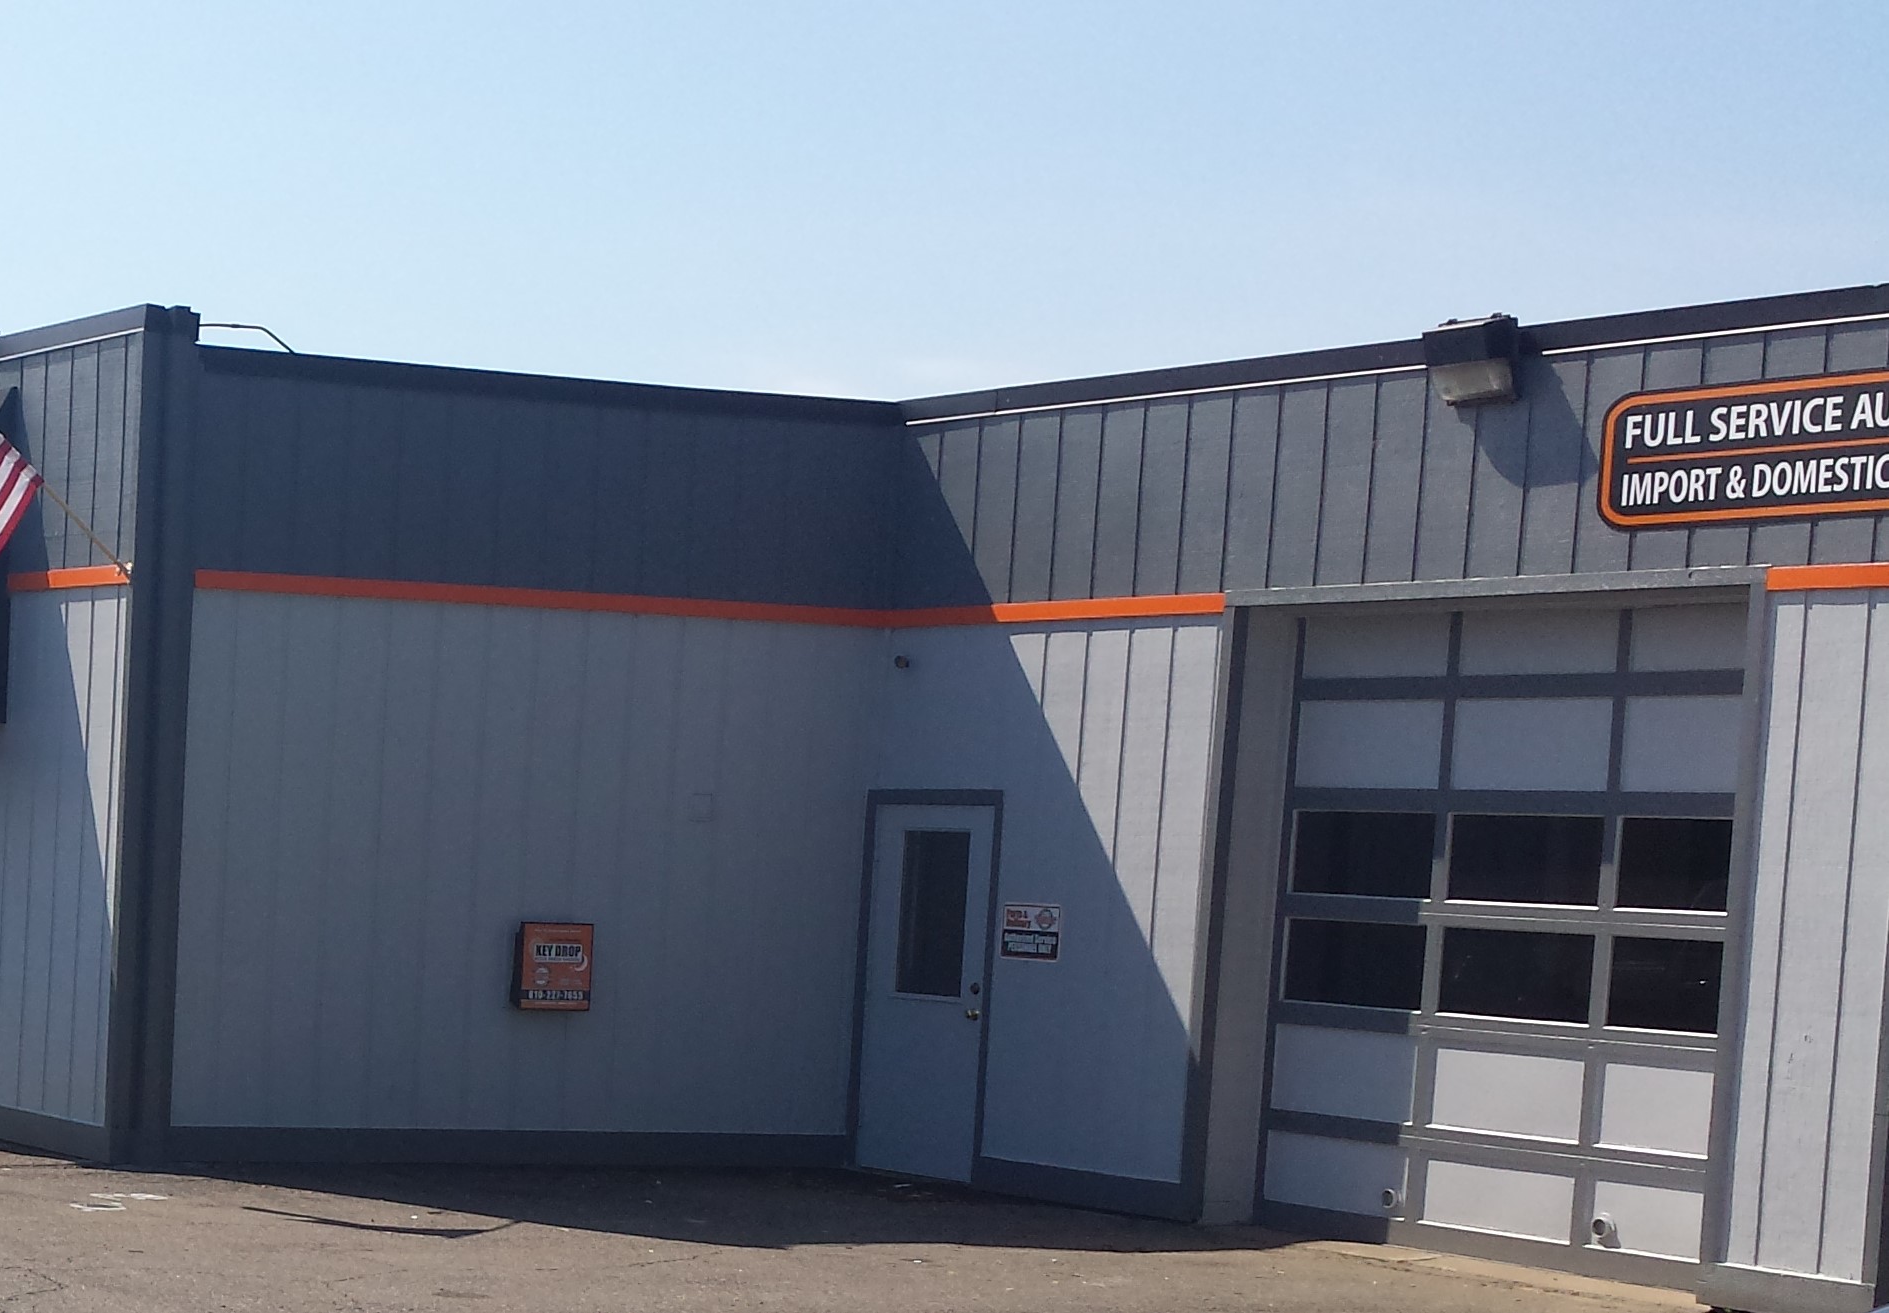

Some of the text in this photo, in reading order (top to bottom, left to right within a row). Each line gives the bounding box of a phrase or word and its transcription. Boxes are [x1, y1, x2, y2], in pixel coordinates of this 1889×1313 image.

[1624, 410, 1701, 449] FULL
[1708, 396, 1844, 442] SERVICE
[1620, 466, 1722, 507] IMPORT
[1725, 465, 1747, 499] &
[536, 944, 581, 957] KEY DROP
[528, 990, 584, 1000] 810-227-7655
